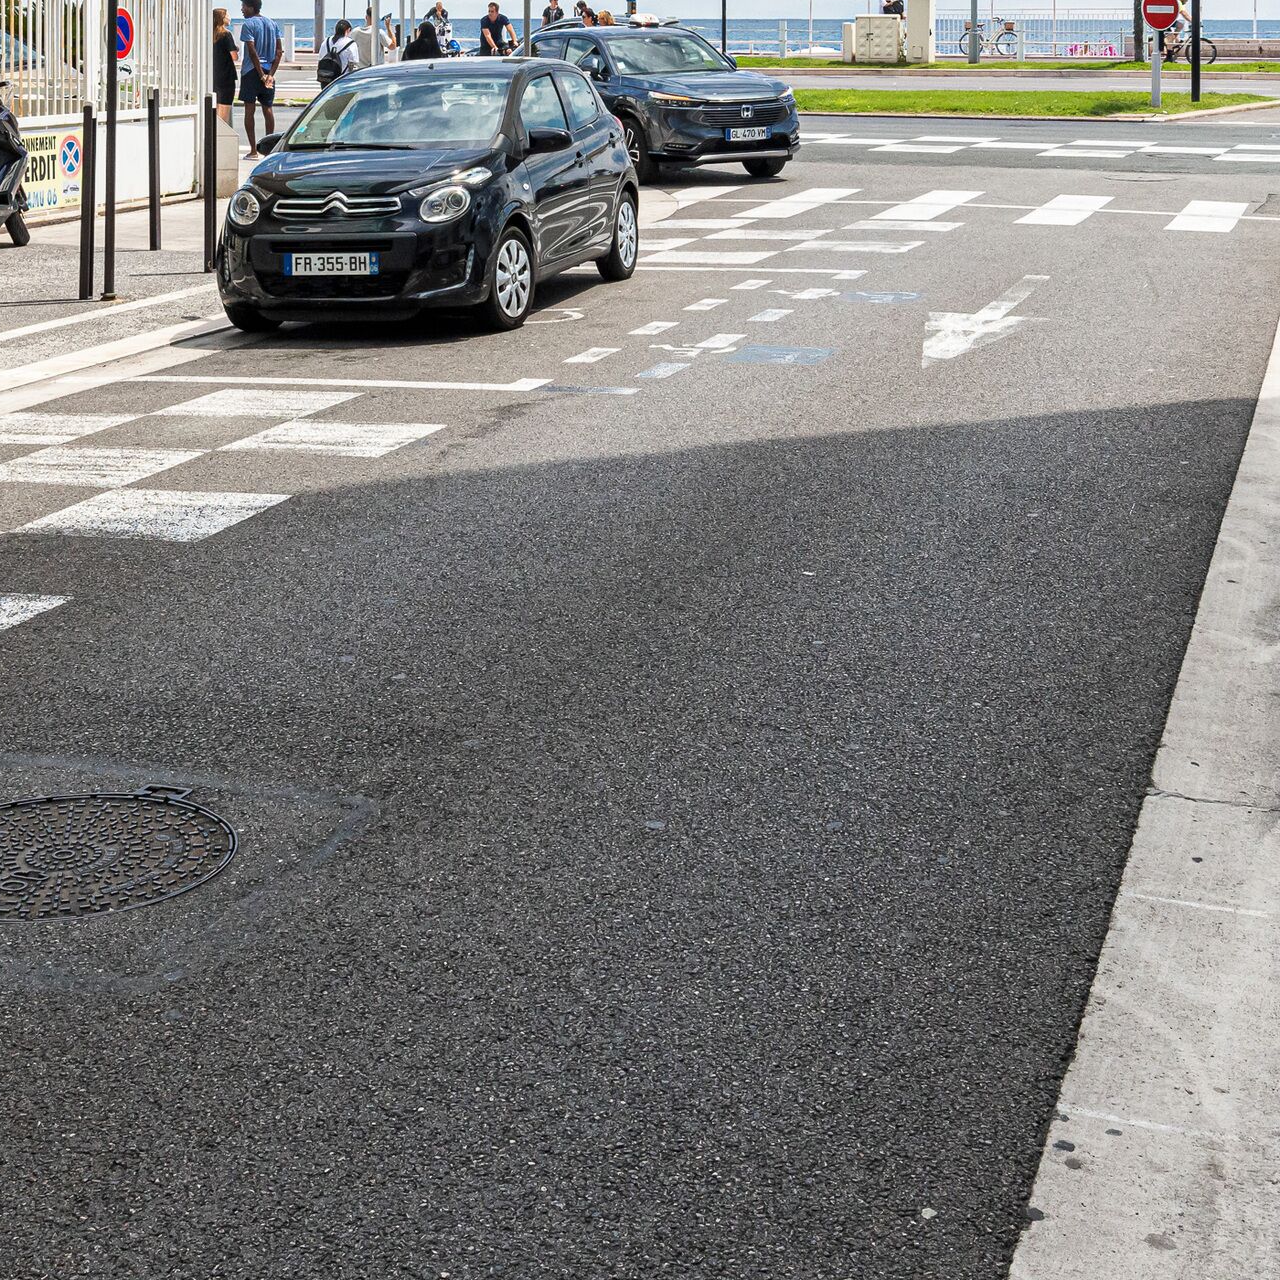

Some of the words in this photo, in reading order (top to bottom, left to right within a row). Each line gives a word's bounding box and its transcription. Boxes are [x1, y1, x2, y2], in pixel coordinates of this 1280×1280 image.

[22, 136, 57, 152] ONNEMENT
[24, 154, 57, 183] ERDIT
[27, 189, 45, 209] AMU
[47, 185, 58, 206] 06
[294, 256, 368, 272] FR-355-BH
